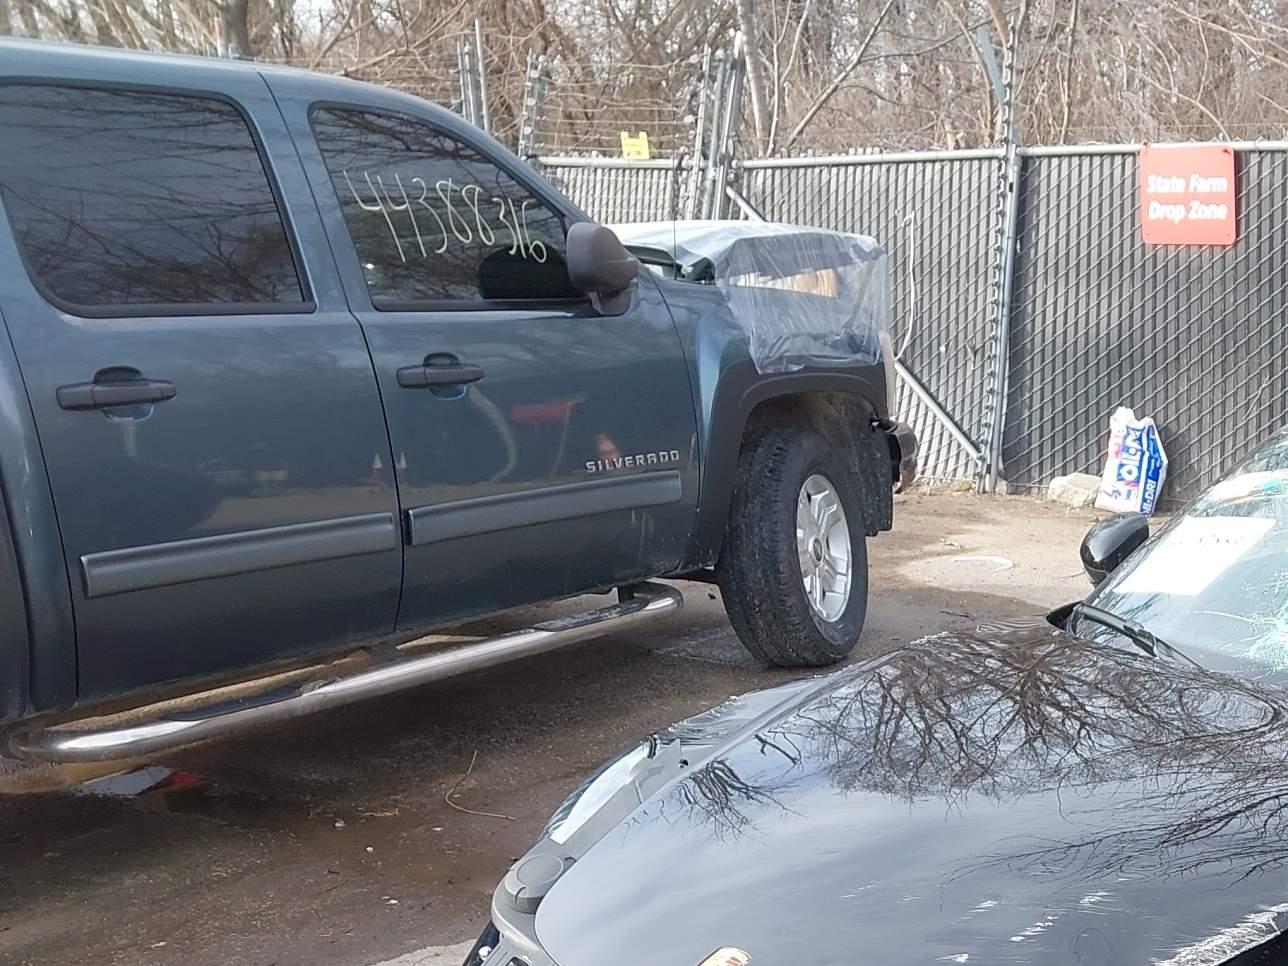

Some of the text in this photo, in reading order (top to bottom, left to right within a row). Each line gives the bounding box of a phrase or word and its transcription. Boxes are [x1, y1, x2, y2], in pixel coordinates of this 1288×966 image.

[1147, 174, 1228, 193] State Farm
[1148, 200, 1227, 224] Drop Zone
[585, 450, 680, 473] SILVERADO
